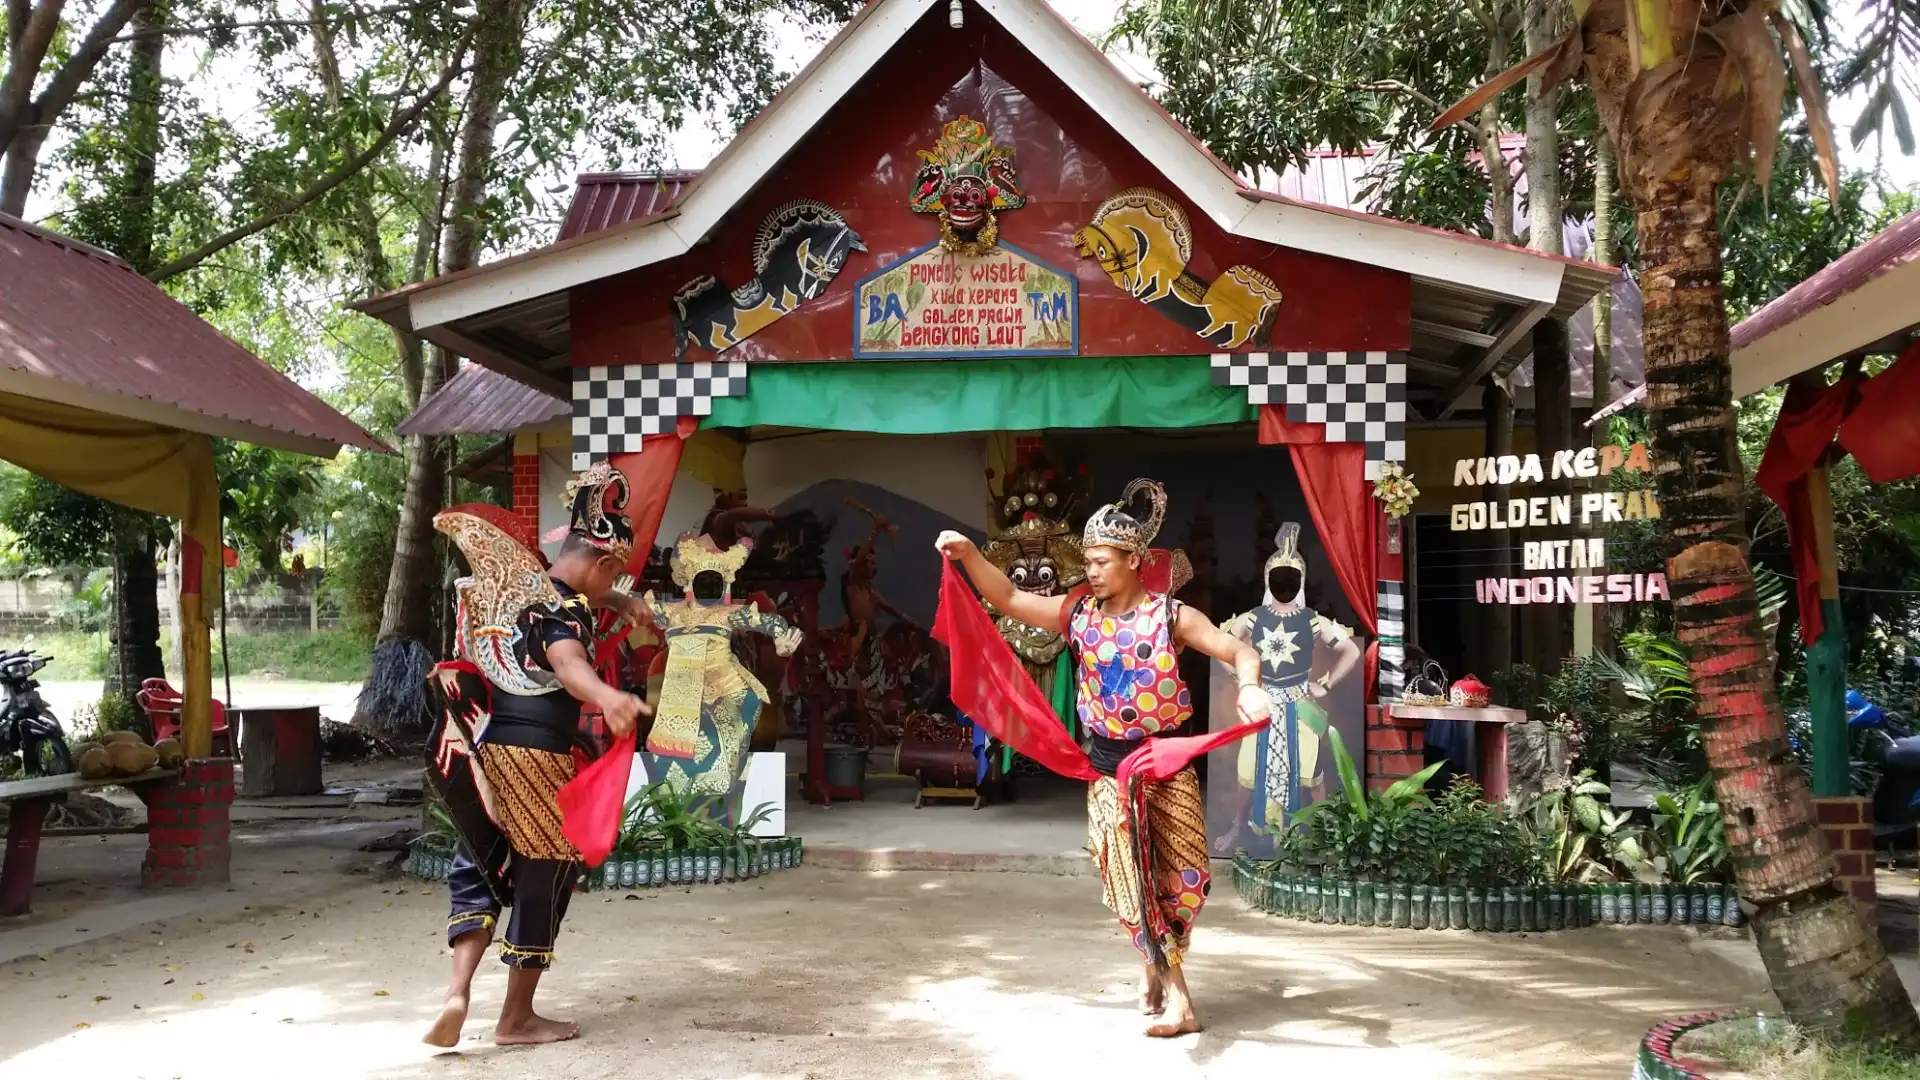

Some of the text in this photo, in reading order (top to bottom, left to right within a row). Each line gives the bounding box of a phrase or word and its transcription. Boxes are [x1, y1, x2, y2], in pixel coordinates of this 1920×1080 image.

[867, 292, 908, 325] BA
[1026, 292, 1069, 321] TAM
[1453, 453, 1544, 487] KUDA
[1451, 494, 1571, 531] GOLDEN
[1524, 538, 1605, 570] BATAM
[1475, 572, 1671, 605] INDONESIA
